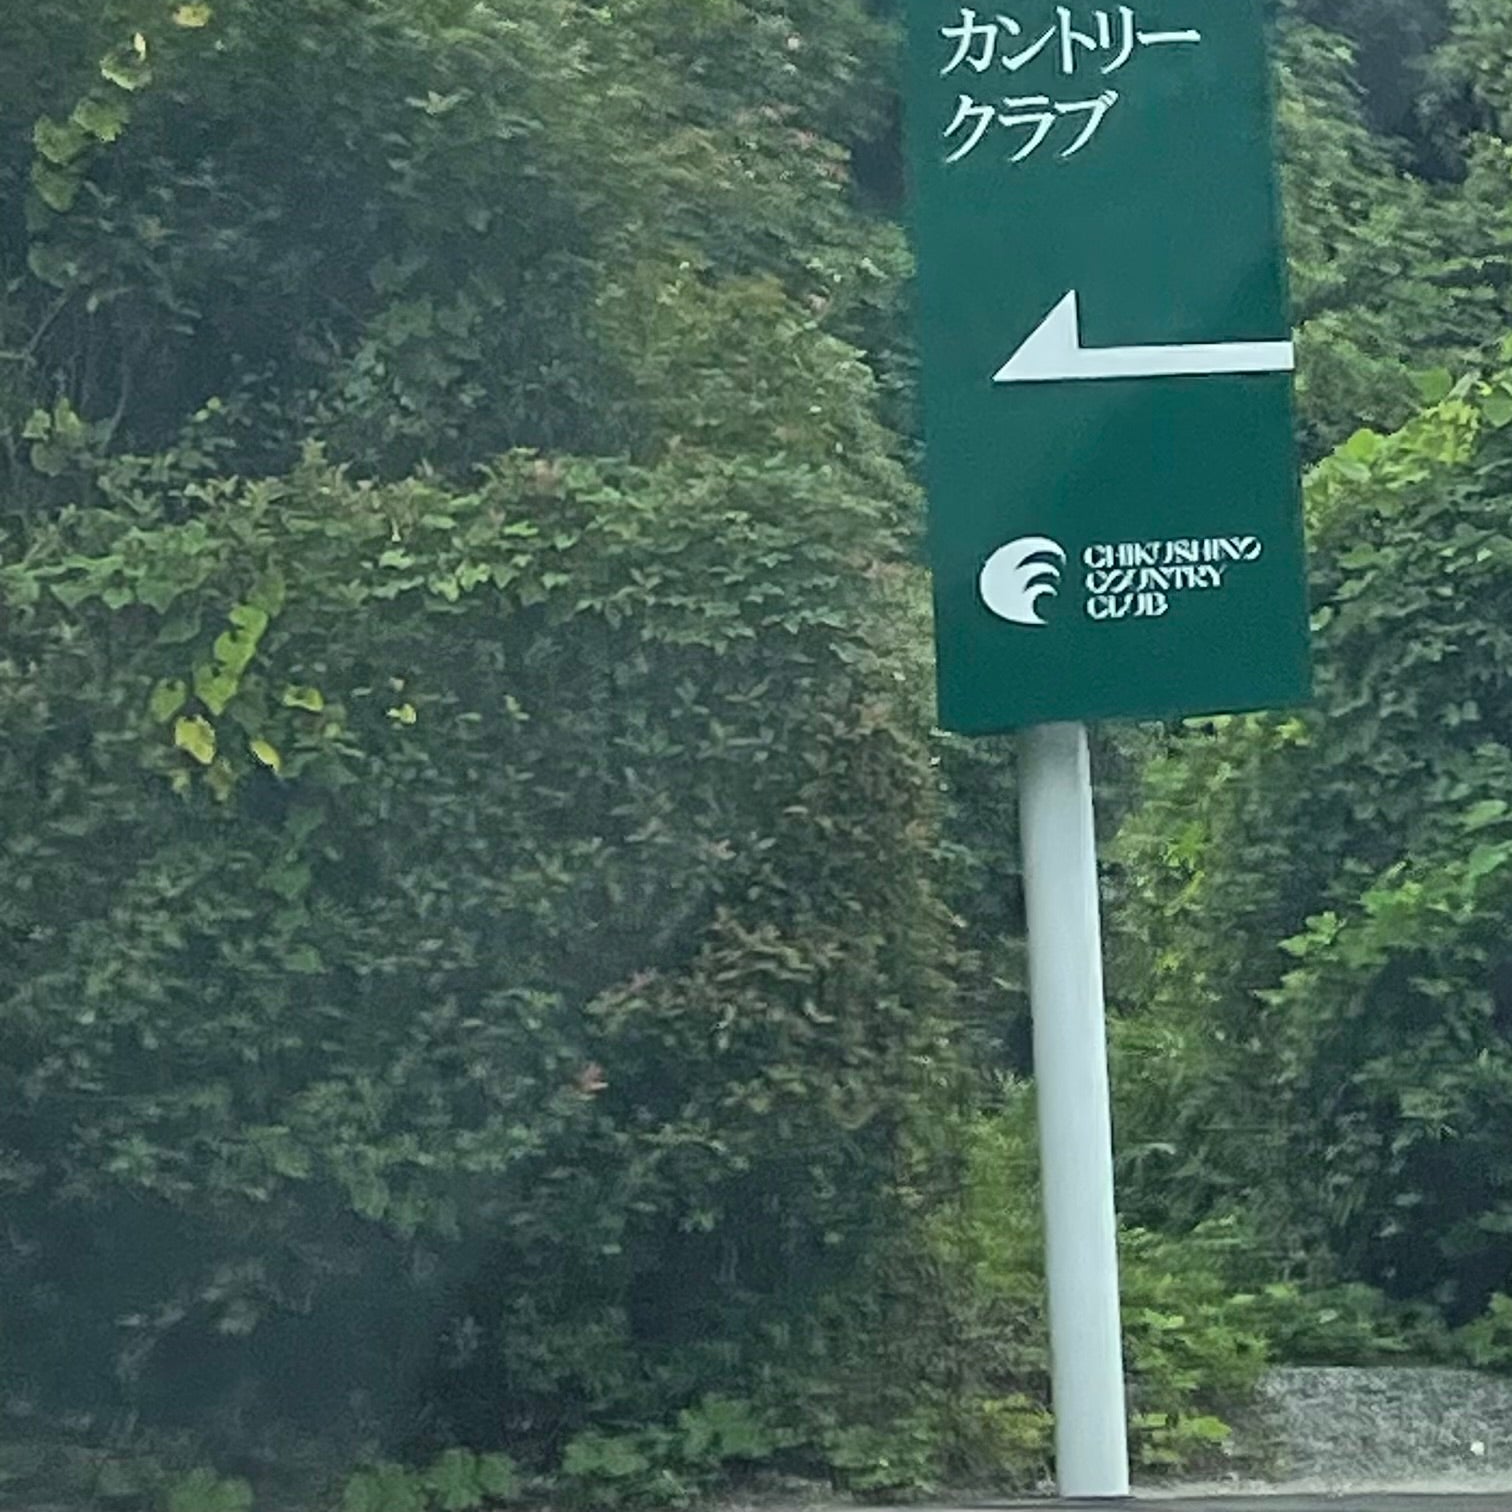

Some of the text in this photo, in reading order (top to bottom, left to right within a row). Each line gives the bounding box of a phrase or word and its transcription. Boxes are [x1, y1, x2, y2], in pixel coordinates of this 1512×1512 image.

[940, 5, 1202, 76] カントリー
[943, 89, 1120, 163] クラブ
[1083, 536, 1262, 569] CHIKUSHINO
[1085, 564, 1227, 594] COUNTRY
[1086, 592, 1169, 620] CLUB
